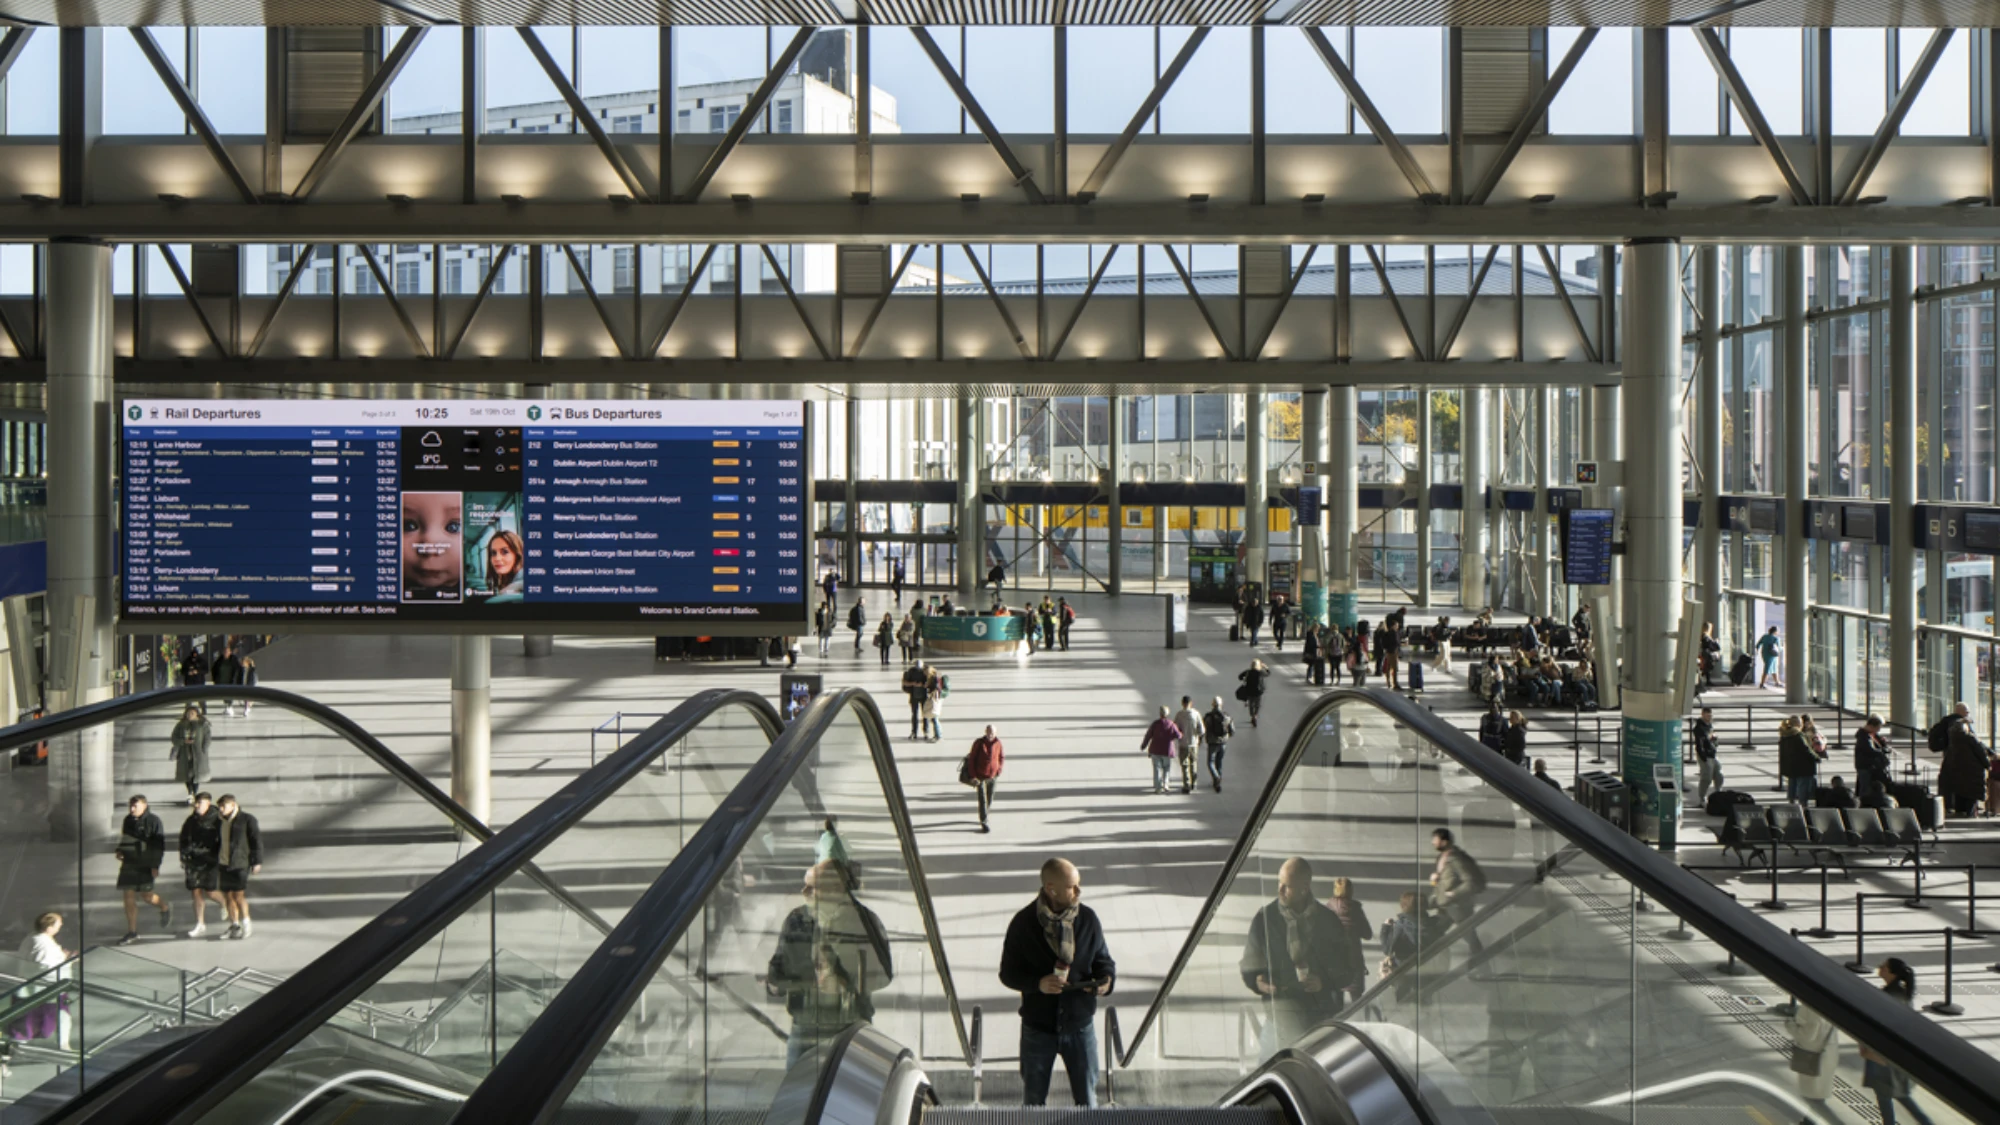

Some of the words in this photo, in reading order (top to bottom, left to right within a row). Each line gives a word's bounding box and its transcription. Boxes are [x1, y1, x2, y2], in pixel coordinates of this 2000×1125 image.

[166, 408, 189, 419] Rail
[192, 408, 261, 421] Departures
[362, 411, 377, 420] Page
[415, 408, 448, 419] 10:25
[565, 408, 589, 419] Bus
[593, 408, 662, 421] Departures
[763, 411, 779, 420] Page
[129, 441, 148, 449] 12:15
[154, 441, 173, 449] Larne
[174, 441, 202, 449] Harbour
[345, 441, 350, 449] 2
[377, 441, 395, 449] 12:15
[553, 441, 573, 451] Derry
[574, 441, 618, 451] Londonderry
[620, 441, 633, 449] Bus
[634, 441, 658, 449] Station
[154, 459, 179, 468] Bangor
[345, 459, 350, 467] 1
[553, 459, 577, 467] Dublin
[578, 459, 602, 469] Airport
[603, 459, 624, 467] Dublin
[625, 459, 648, 469] Airport
[649, 459, 658, 467] T2
[154, 477, 191, 485] Portadown
[345, 477, 350, 485] 7
[553, 477, 582, 487] Armagh
[582, 477, 608, 487] Armagh
[610, 477, 622, 485] Bus
[624, 477, 647, 485] Station
[747, 477, 756, 485] 17
[154, 495, 179, 503] Lisburn
[553, 495, 592, 505] Aldergrove
[593, 495, 616, 503] Belfast
[617, 495, 657, 503] International
[658, 495, 681, 505] Airport
[154, 513, 190, 521] Whitehead
[345, 513, 350, 521] 2
[553, 513, 576, 523] Newry
[577, 513, 598, 523] Newry
[600, 513, 613, 521] Bus
[614, 513, 638, 521] Station
[1828, 513, 1836, 529] 4
[1948, 520, 1958, 537] 5
[154, 531, 179, 540] Bangor
[345, 531, 350, 539] 1
[553, 531, 573, 541] Derry
[574, 531, 618, 541] Londonderry
[620, 531, 633, 539] Bus
[634, 531, 658, 539] Station
[154, 549, 191, 557] Portadown
[345, 549, 350, 557] 7
[553, 549, 591, 559] Sydenham
[591, 549, 616, 559] George
[617, 549, 632, 557] Best
[633, 549, 657, 557] Belfast
[658, 549, 671, 559] City
[672, 549, 695, 559] Airport
[553, 567, 593, 575] Cookstown
[595, 567, 613, 575] Union
[615, 567, 635, 575] Street
[158, 606, 166, 614] or
[168, 606, 180, 614] see
[181, 606, 210, 615] anything
[212, 606, 241, 615] unusual,
[243, 606, 265, 615] please
[266, 606, 287, 615] speak
[289, 606, 297, 614] to
[298, 606, 303, 614] a
[304, 606, 333, 614] member
[334, 606, 342, 614] of
[343, 606, 360, 614] staff.
[361, 606, 375, 614] See
[640, 606, 672, 614] Welcome
[674, 606, 682, 614] to
[683, 606, 705, 614] Grand
[706, 606, 732, 614] Central
[733, 606, 760, 614] Station.
[136, 650, 150, 666] M&S
